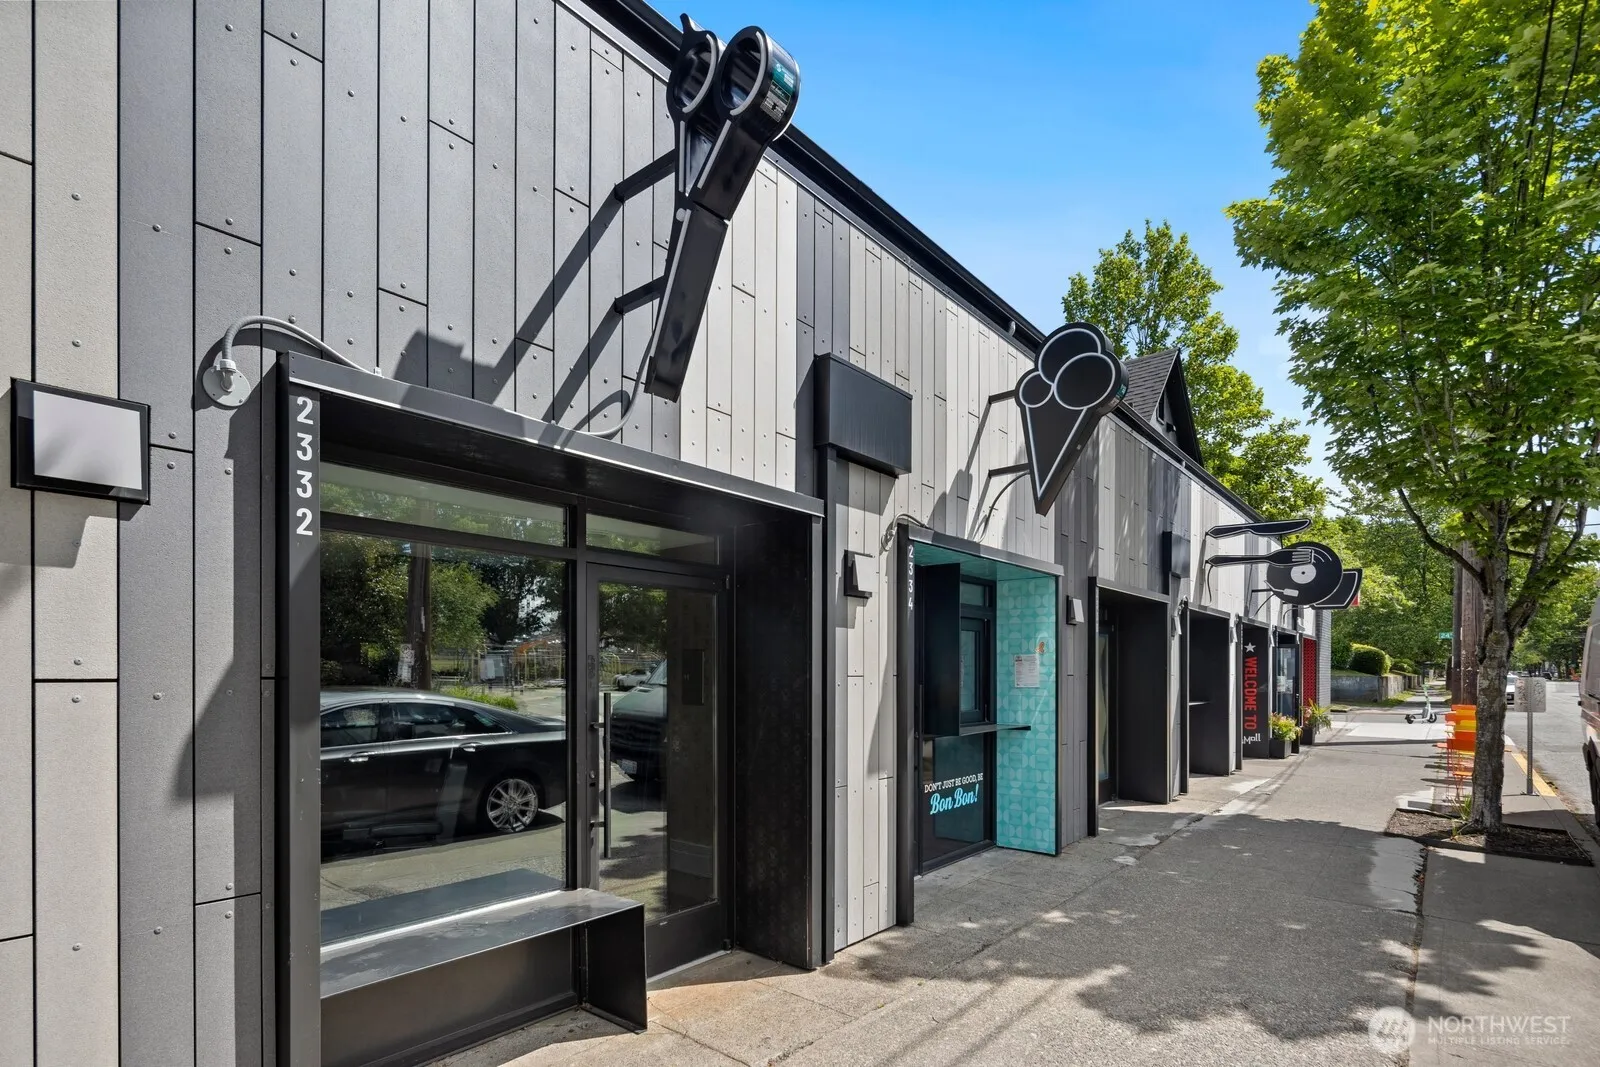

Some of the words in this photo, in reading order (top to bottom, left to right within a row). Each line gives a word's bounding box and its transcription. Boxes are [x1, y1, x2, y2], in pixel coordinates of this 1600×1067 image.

[296, 396, 314, 536] 2332
[1244, 656, 1258, 711] WELCOME
[1244, 714, 1257, 730] TO
[942, 779, 955, 789] JUST
[955, 777, 962, 787] BE
[962, 774, 978, 784] GOOD,
[977, 772, 984, 781] BE
[930, 792, 954, 815] Bon
[953, 783, 979, 808] Bon!
